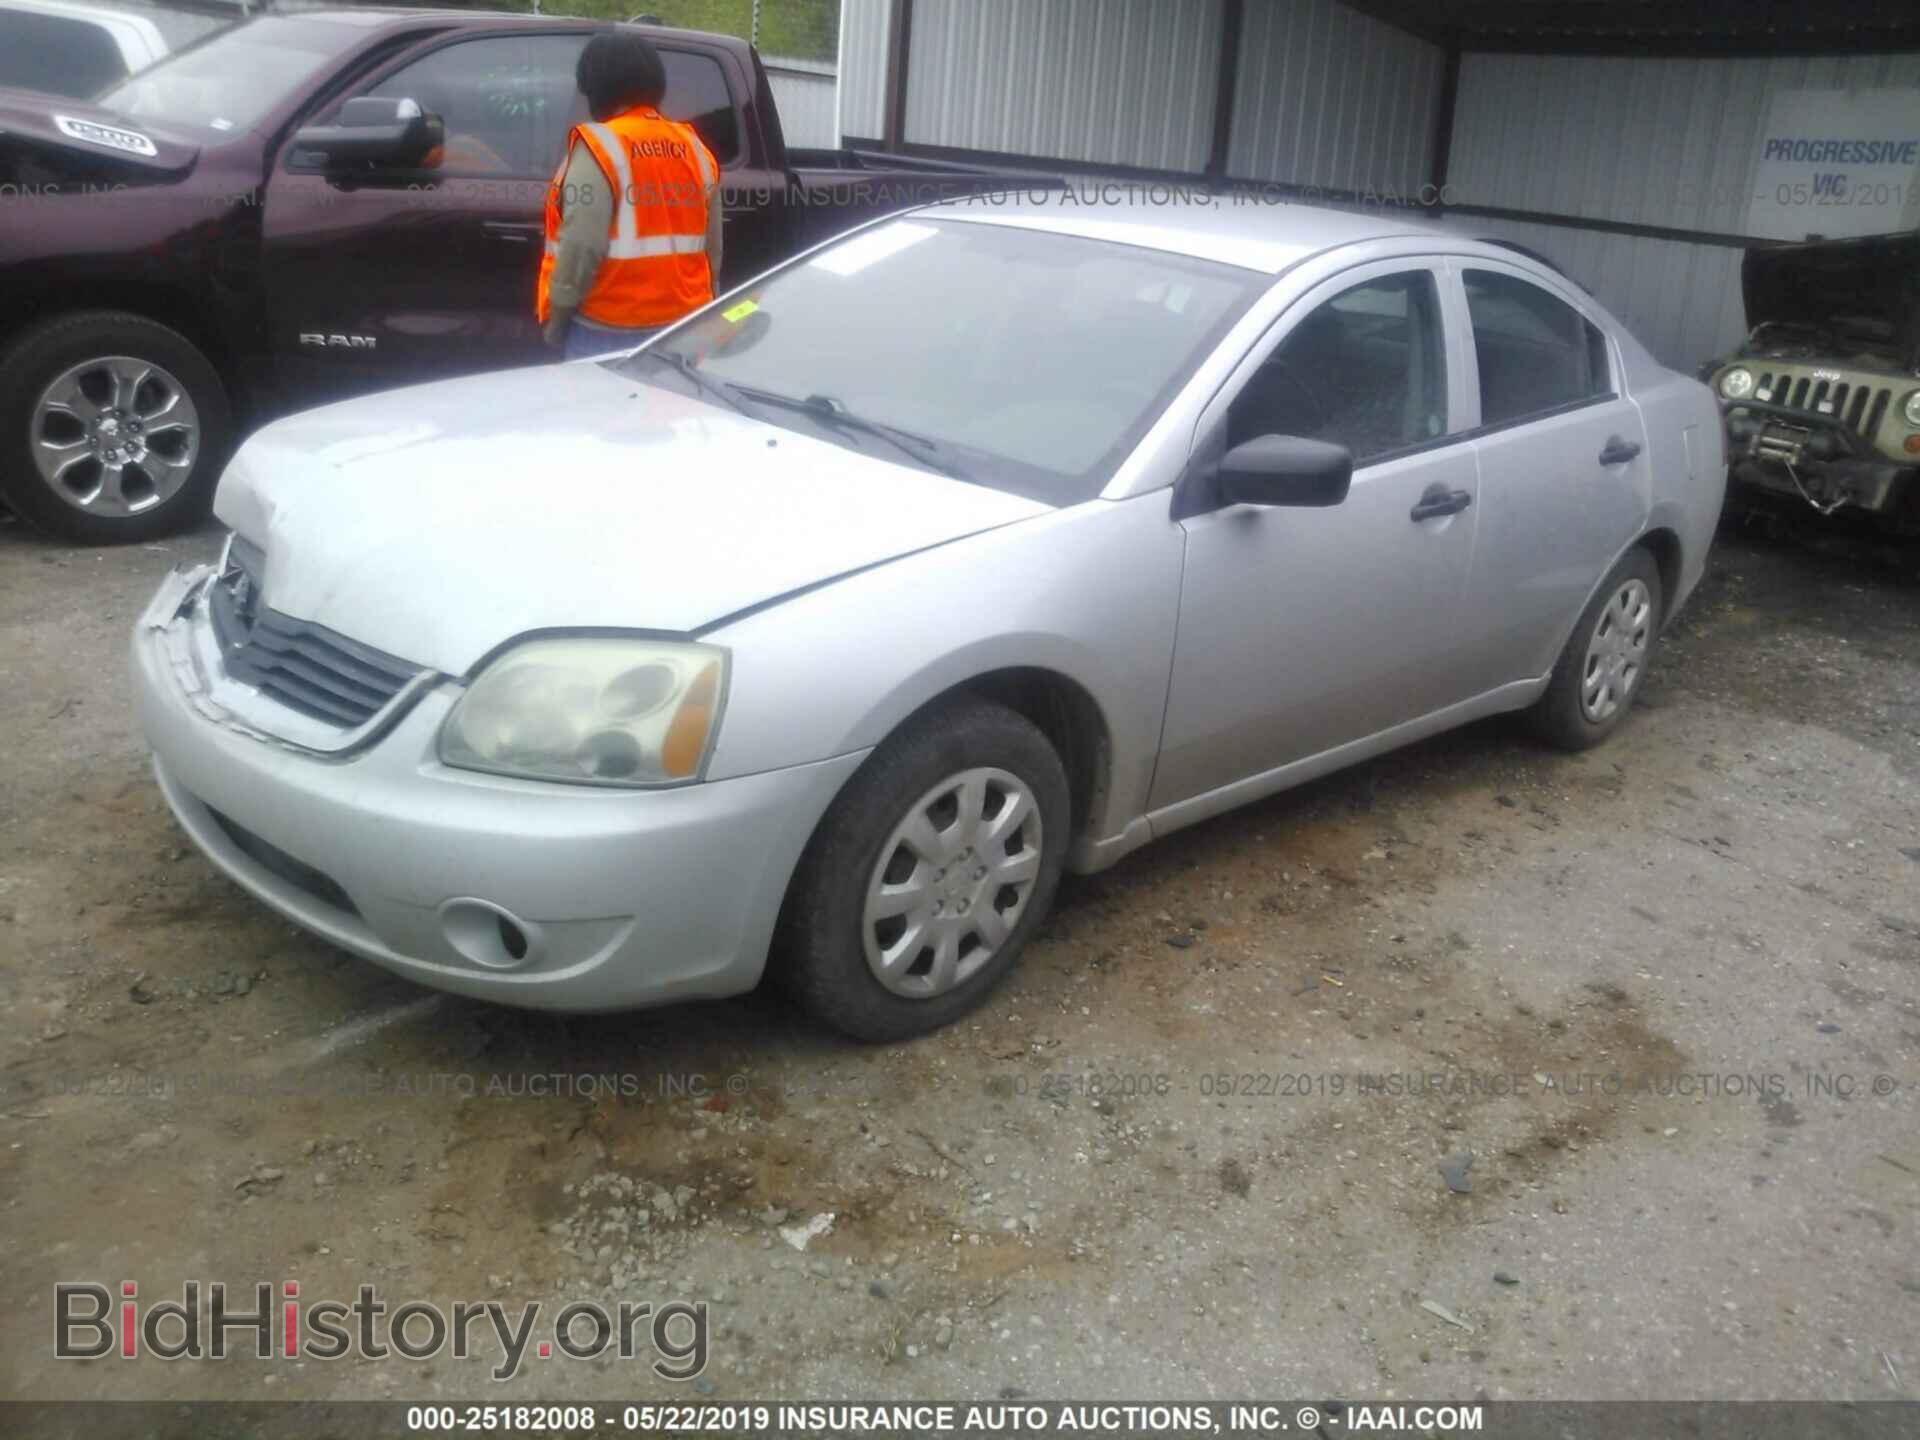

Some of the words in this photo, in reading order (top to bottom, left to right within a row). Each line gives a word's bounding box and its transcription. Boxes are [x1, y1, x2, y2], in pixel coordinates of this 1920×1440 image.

[631, 139, 687, 158] AGENCY
[1764, 139, 1918, 164] PROGRESSIVE
[299, 333, 376, 348] RAM
